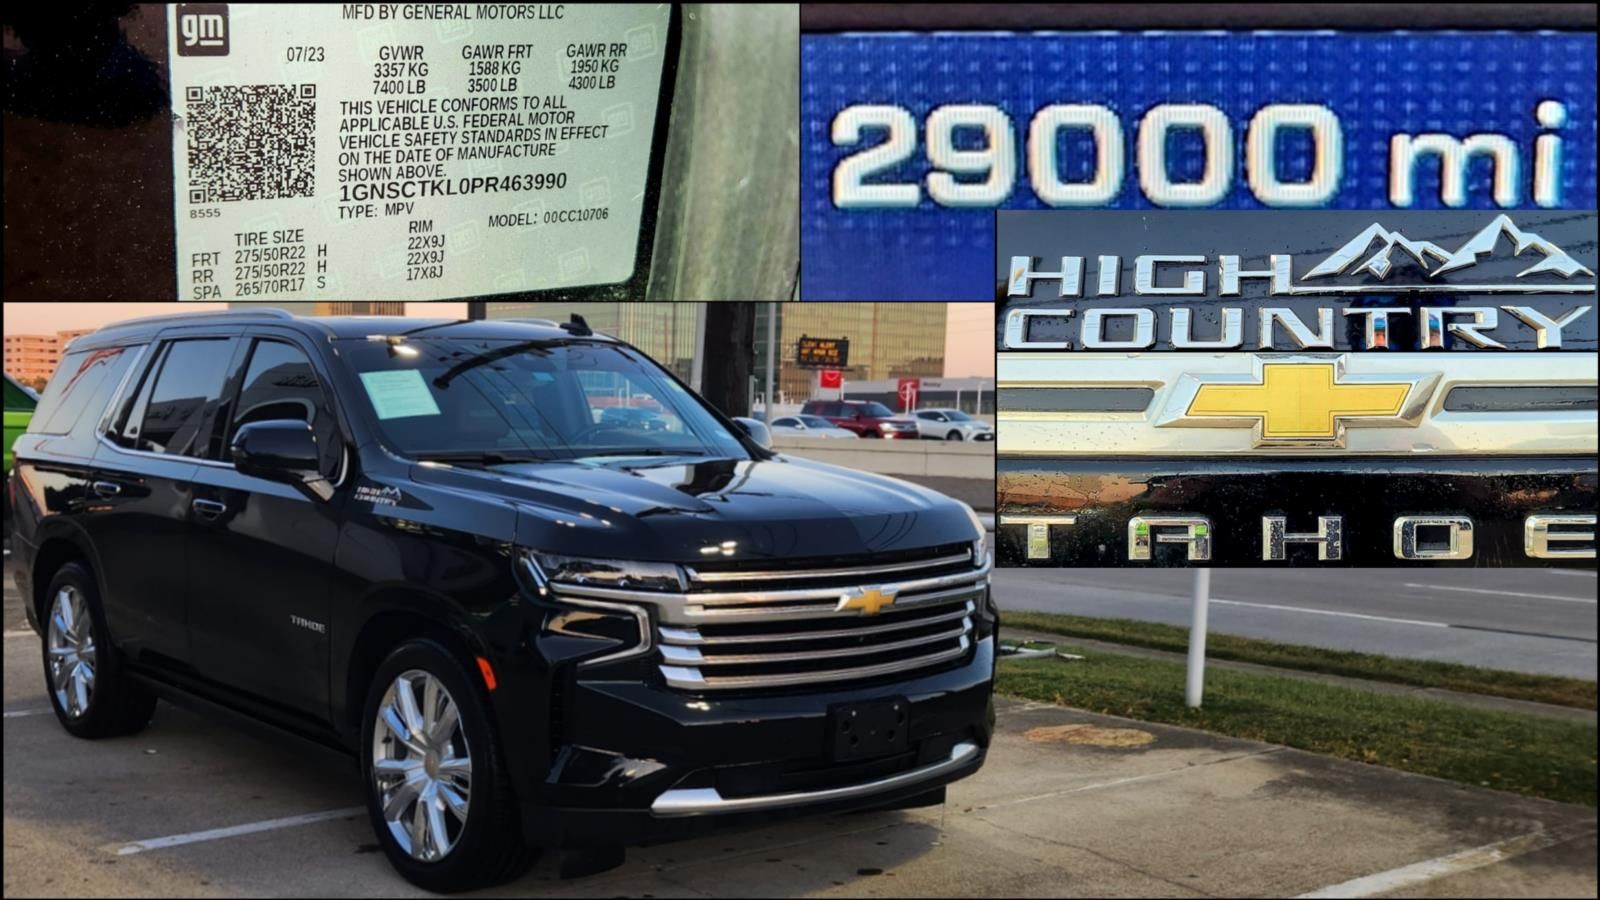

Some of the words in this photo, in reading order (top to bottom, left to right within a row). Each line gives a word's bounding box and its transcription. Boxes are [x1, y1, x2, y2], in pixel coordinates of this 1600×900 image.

[342, 4, 375, 20] MFD
[379, 4, 399, 20] BY
[402, 4, 471, 20] GENERAL
[476, 4, 535, 20] MOTORS
[539, 4, 565, 20] LLC
[286, 46, 325, 62] 07/23
[379, 45, 424, 61] GVWR
[461, 44, 505, 60] GAWR
[507, 43, 534, 59] FRT
[566, 43, 606, 58] GAWR
[608, 42, 628, 57] RR
[374, 62, 406, 78] 3357
[408, 61, 429, 77] KG
[469, 61, 499, 76] 1588
[501, 60, 521, 75] KG
[570, 59, 599, 74] 1950
[600, 58, 620, 73] KG
[372, 80, 404, 95] 7400
[407, 79, 426, 94] LB
[467, 78, 498, 93] 3500
[500, 77, 518, 92] LB
[568, 76, 596, 90] 4300
[599, 75, 616, 89] LB
[340, 100, 373, 116] THIS
[376, 98, 437, 115] VEHICLE
[441, 96, 518, 113] CONFORMS
[523, 95, 540, 110] TO
[543, 95, 567, 109] ALL
[339, 115, 430, 133] APPLICABLE
[433, 114, 459, 130] U.S.
[463, 112, 524, 128] FEDERAL
[527, 110, 575, 126] MOTOR
[339, 133, 401, 149] VEHICLE
[404, 131, 457, 147] SAFETY
[461, 127, 541, 145] STANDARDS
[544, 127, 558, 141] IN
[560, 124, 609, 140] EFFECT
[339, 151, 360, 166] ON
[364, 150, 392, 165] THE
[395, 148, 432, 164] DATE
[435, 147, 454, 161] OF
[457, 142, 557, 161] MANUFACTURE
[831, 102, 1342, 210] 29000
[1388, 99, 1567, 209] mi
[338, 166, 392, 183] SHOWN
[396, 163, 447, 180] ABOVE.
[339, 172, 568, 202] 1GNSCTKL0PR463990
[190, 207, 221, 219] 8555
[338, 203, 378, 219] TYPE:
[385, 201, 415, 217] MPV
[488, 212, 537, 228] MODEL:
[543, 207, 609, 224] 00CC10706
[408, 219, 433, 234] RIM
[234, 231, 268, 247] TIRE
[272, 228, 305, 244] SIZE
[407, 234, 446, 251] 22X9J
[234, 245, 306, 265] 275/50R22
[317, 243, 327, 257] H
[406, 249, 445, 266] 22X9J
[192, 251, 221, 268] FRT
[317, 259, 327, 273] H
[192, 268, 214, 284] RR
[234, 261, 306, 281] 275/50R22
[406, 265, 444, 282] 17X8J
[1007, 254, 1295, 298] HIGH
[235, 277, 305, 297] 265/70R17
[316, 275, 326, 289] S
[193, 284, 222, 300] SPA
[1003, 305, 1594, 350] COUNTRY
[998, 514, 1597, 561] TAHOE
